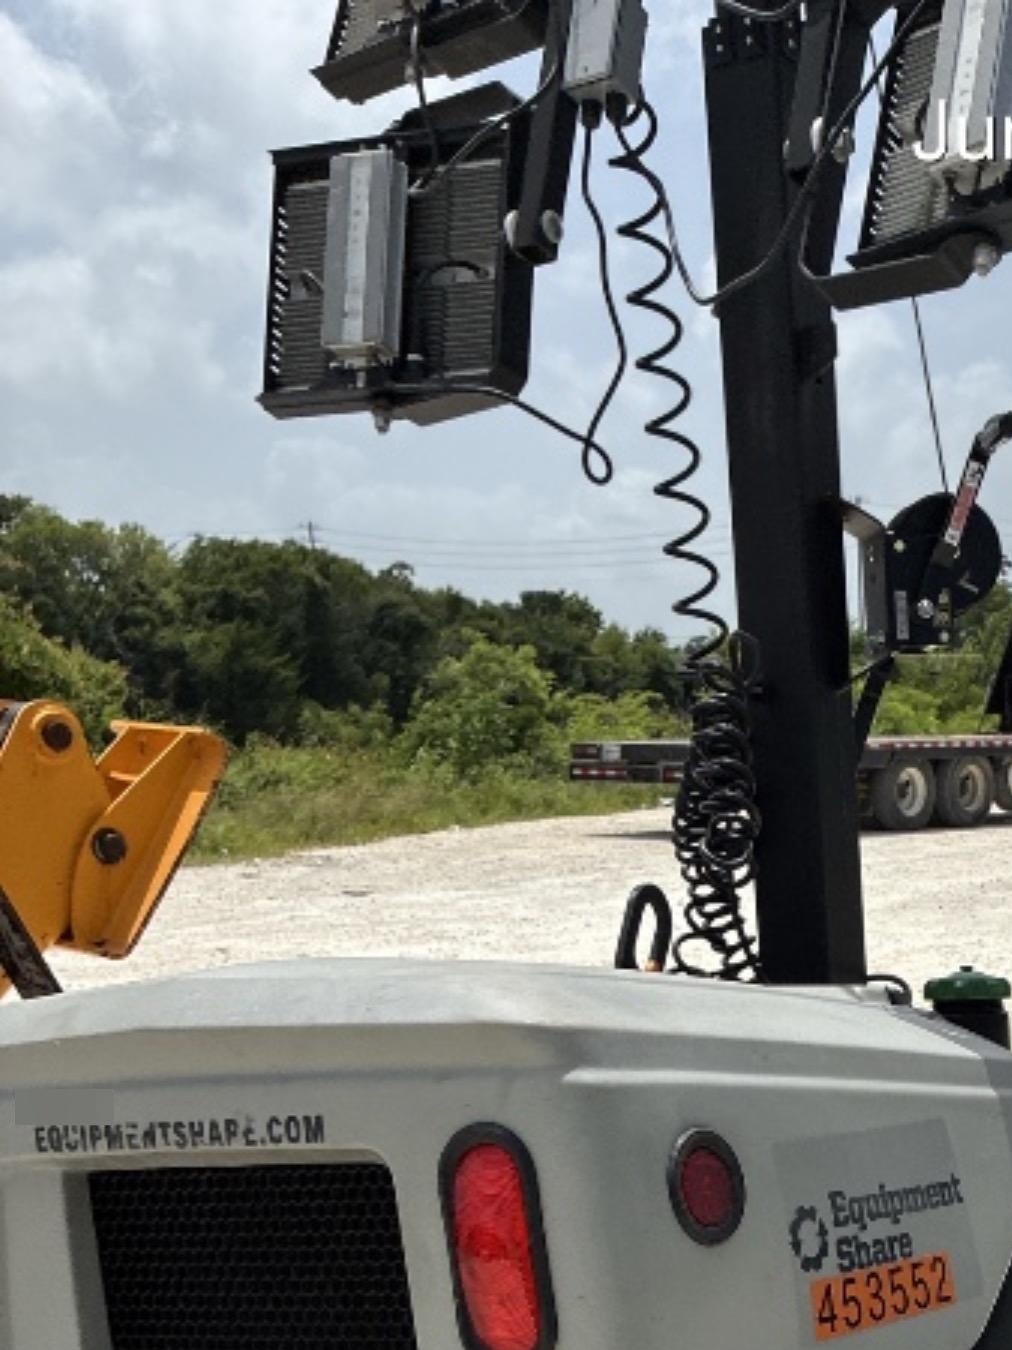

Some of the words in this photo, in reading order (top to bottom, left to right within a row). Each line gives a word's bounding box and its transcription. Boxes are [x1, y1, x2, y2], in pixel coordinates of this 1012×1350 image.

[828, 1172, 964, 1231] Equipment
[836, 1232, 913, 1273] Share
[818, 1256, 953, 1333] 453552
